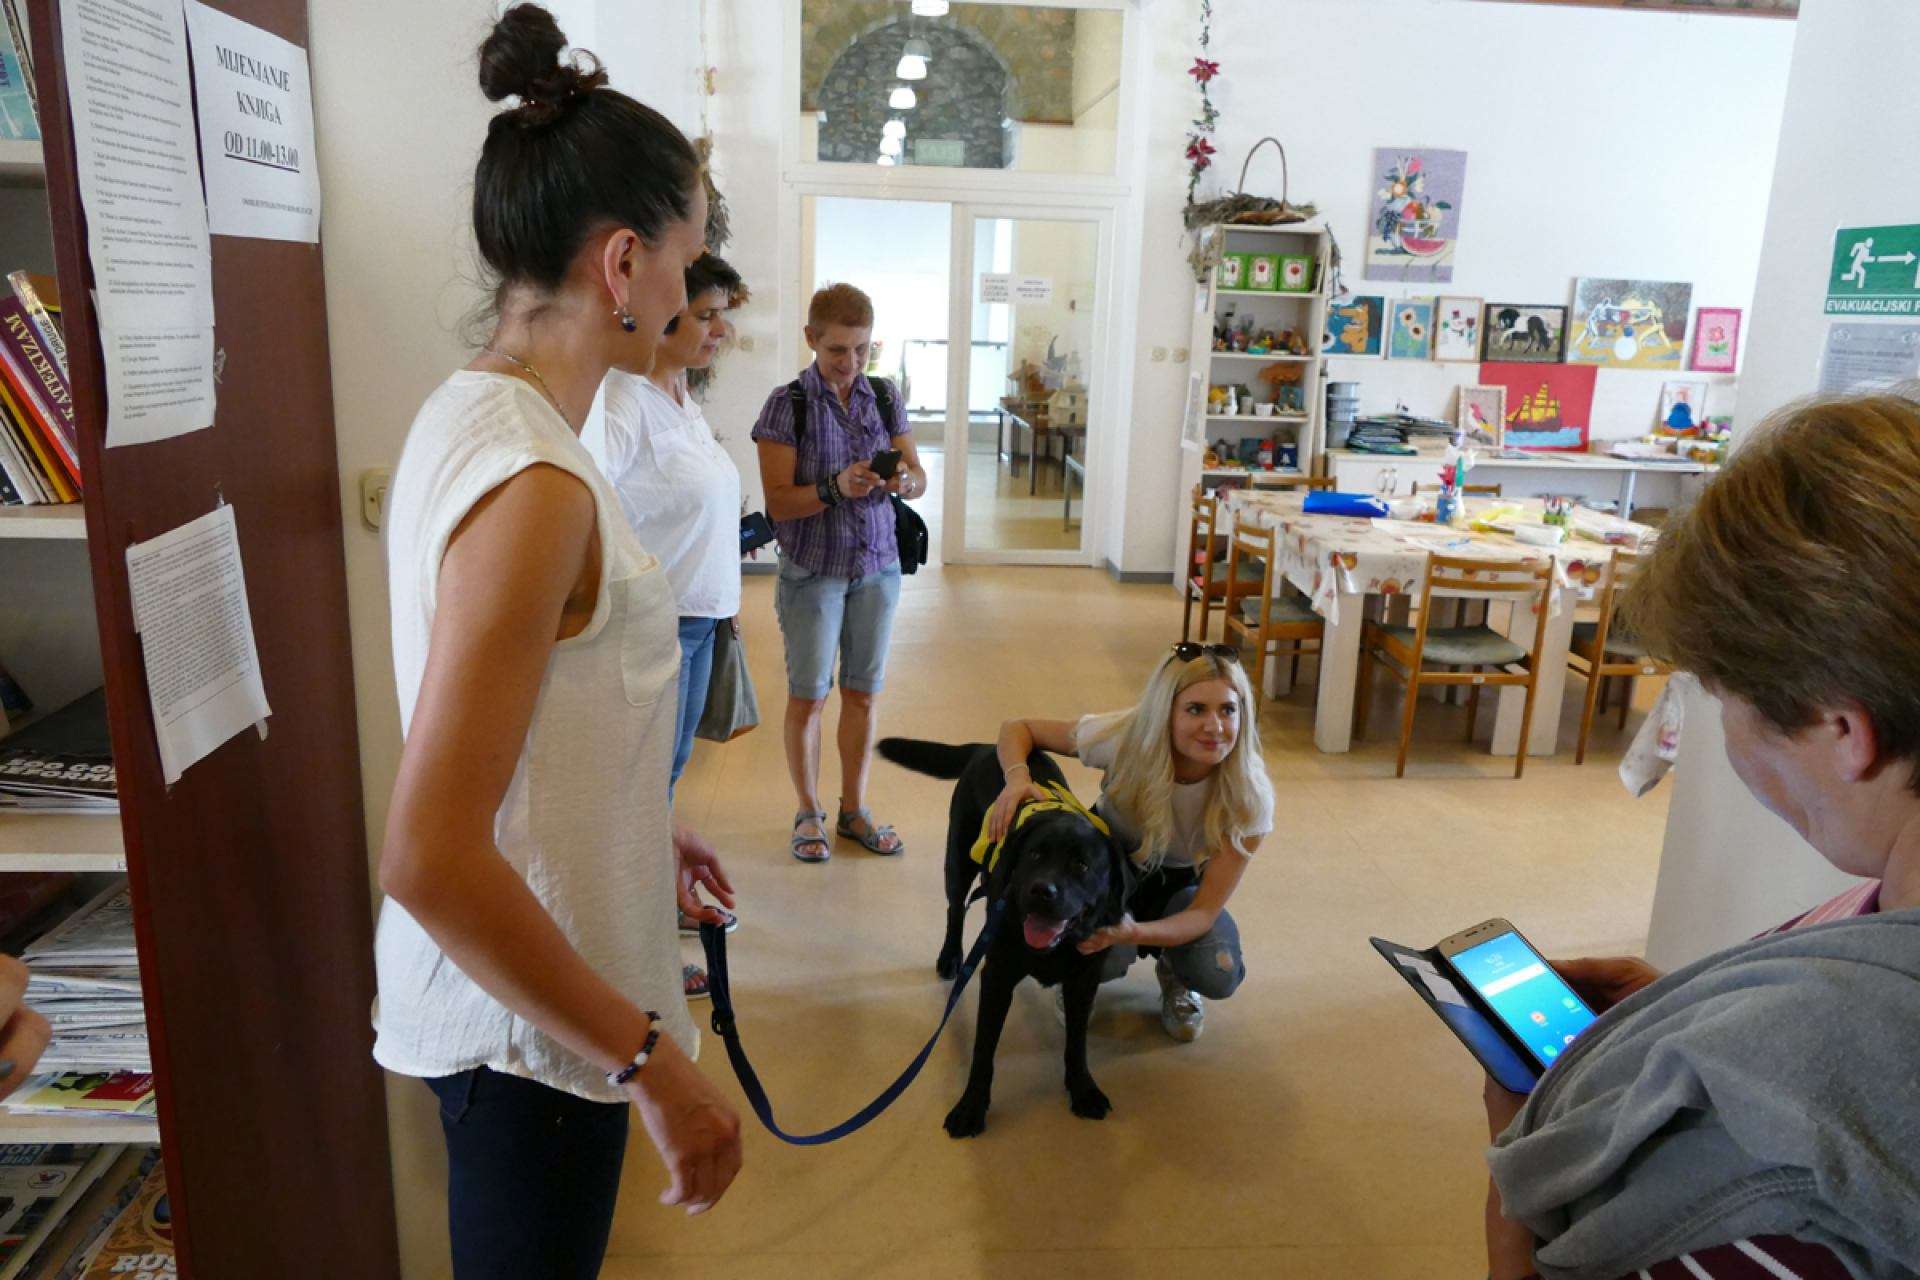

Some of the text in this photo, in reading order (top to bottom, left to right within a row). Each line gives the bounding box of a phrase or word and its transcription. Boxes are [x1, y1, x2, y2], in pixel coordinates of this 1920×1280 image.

[215, 45, 291, 92] MIJENJANJE
[236, 90, 282, 125] KNJIGA
[224, 130, 242, 154] OD
[1826, 299, 1911, 312] EVAKUACIJSKI
